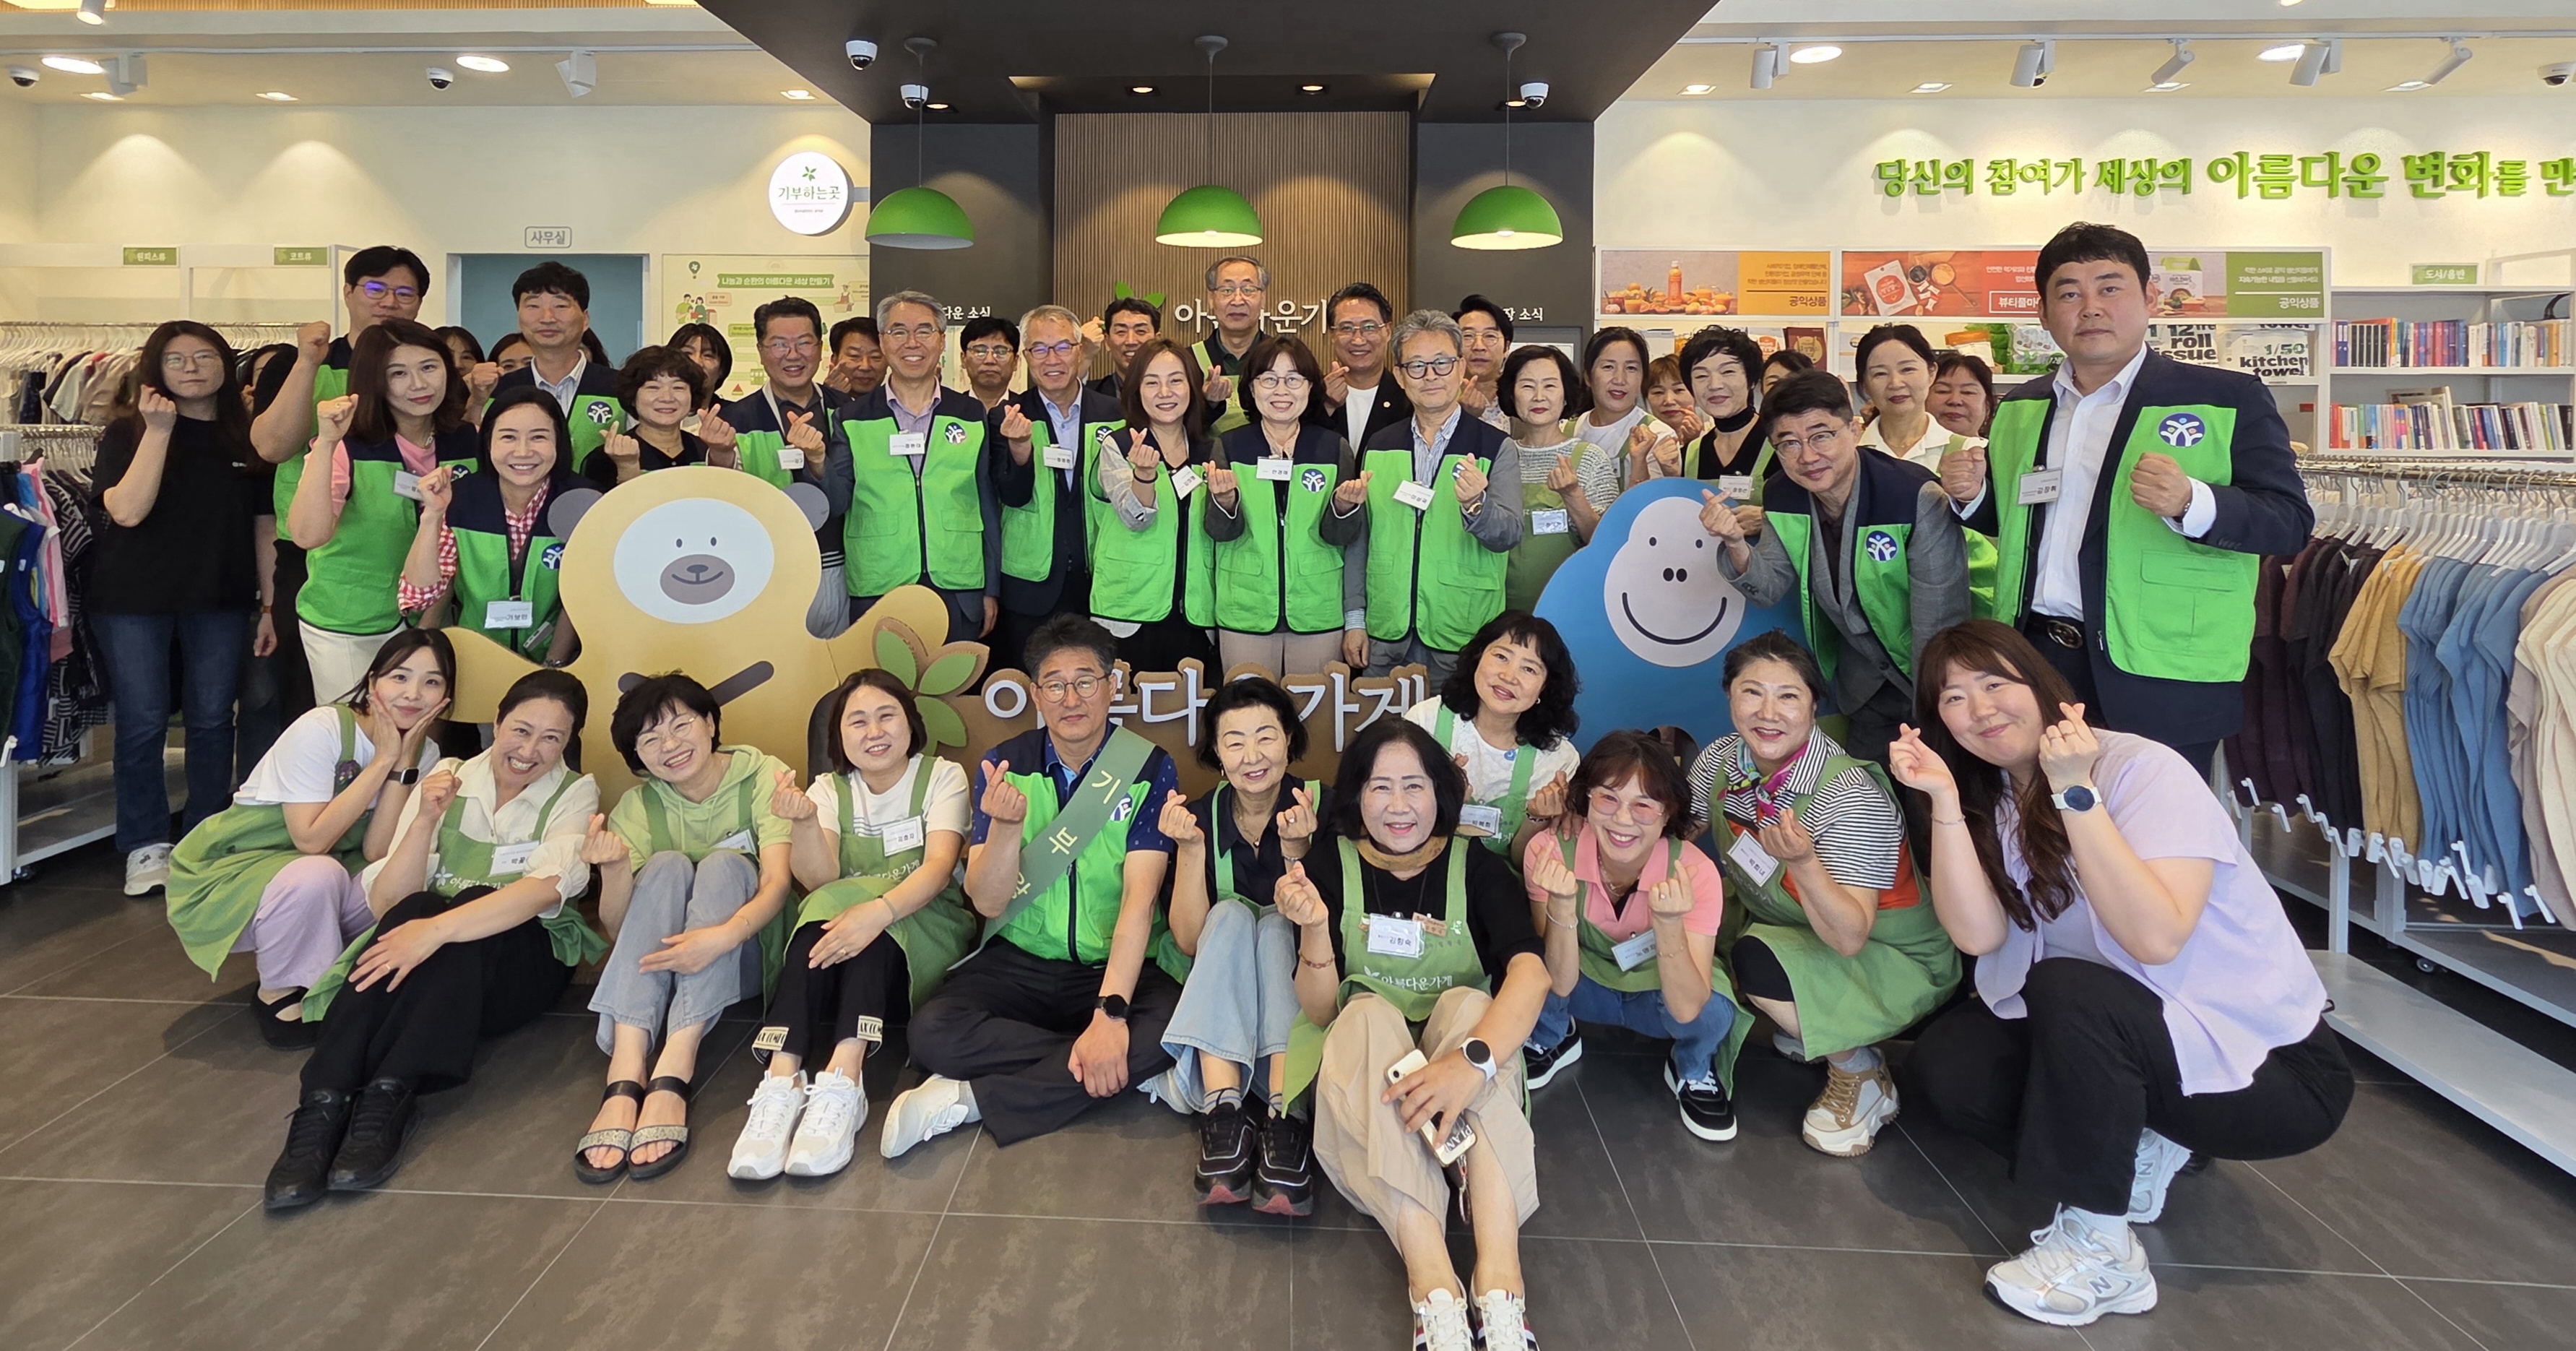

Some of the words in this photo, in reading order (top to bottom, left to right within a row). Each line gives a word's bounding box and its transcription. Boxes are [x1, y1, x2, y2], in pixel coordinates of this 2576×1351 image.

[1877, 158, 1974, 197] 당신의
[1985, 157, 2086, 196] 참여가
[2095, 157, 2192, 197] 세상의
[2207, 151, 2389, 199] 아름다운
[2400, 151, 2531, 199] 변화를
[777, 186, 841, 200] 기부하는곳
[530, 230, 566, 245] 사무실
[2424, 269, 2465, 280] 도서/음반
[1789, 295, 1828, 307] 공익상품
[2278, 297, 2320, 308] 공익상품
[1518, 307, 1543, 321] 소식
[2171, 334, 2212, 349] roll
[2239, 355, 2309, 368] kitchen
[2088, 1276, 2112, 1295] N
